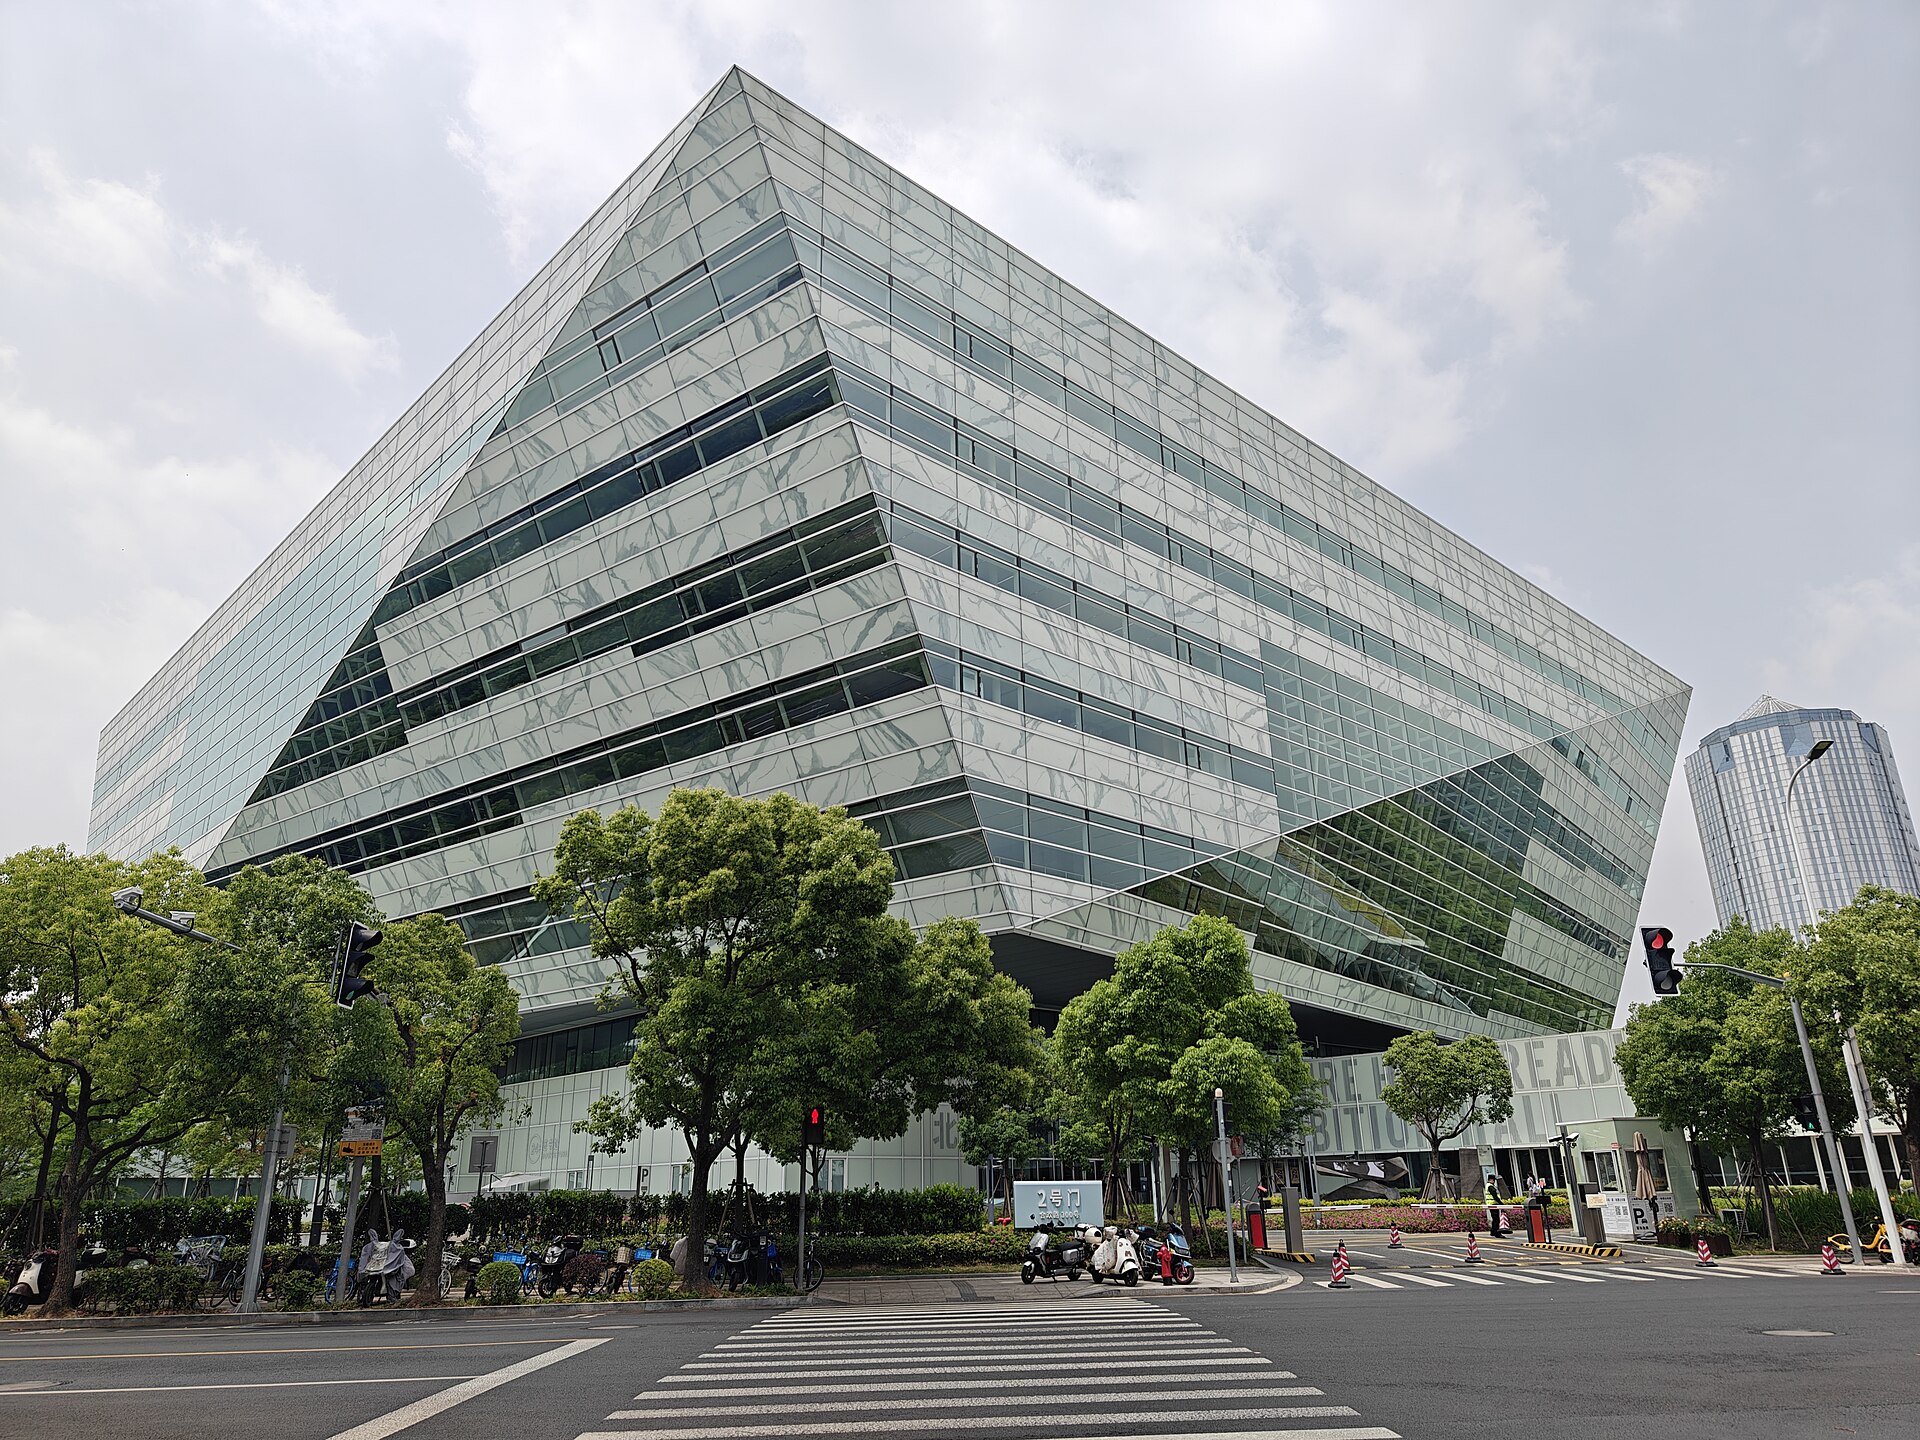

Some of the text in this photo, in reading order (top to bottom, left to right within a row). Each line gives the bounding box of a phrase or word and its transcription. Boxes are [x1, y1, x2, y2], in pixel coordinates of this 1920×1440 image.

[1500, 1033, 1624, 1090] READ
[1300, 1104, 1425, 1152] BITIO
[641, 1168, 649, 1182] P
[1037, 1188, 1081, 1208] 2号门
[1632, 1207, 1645, 1225] P
